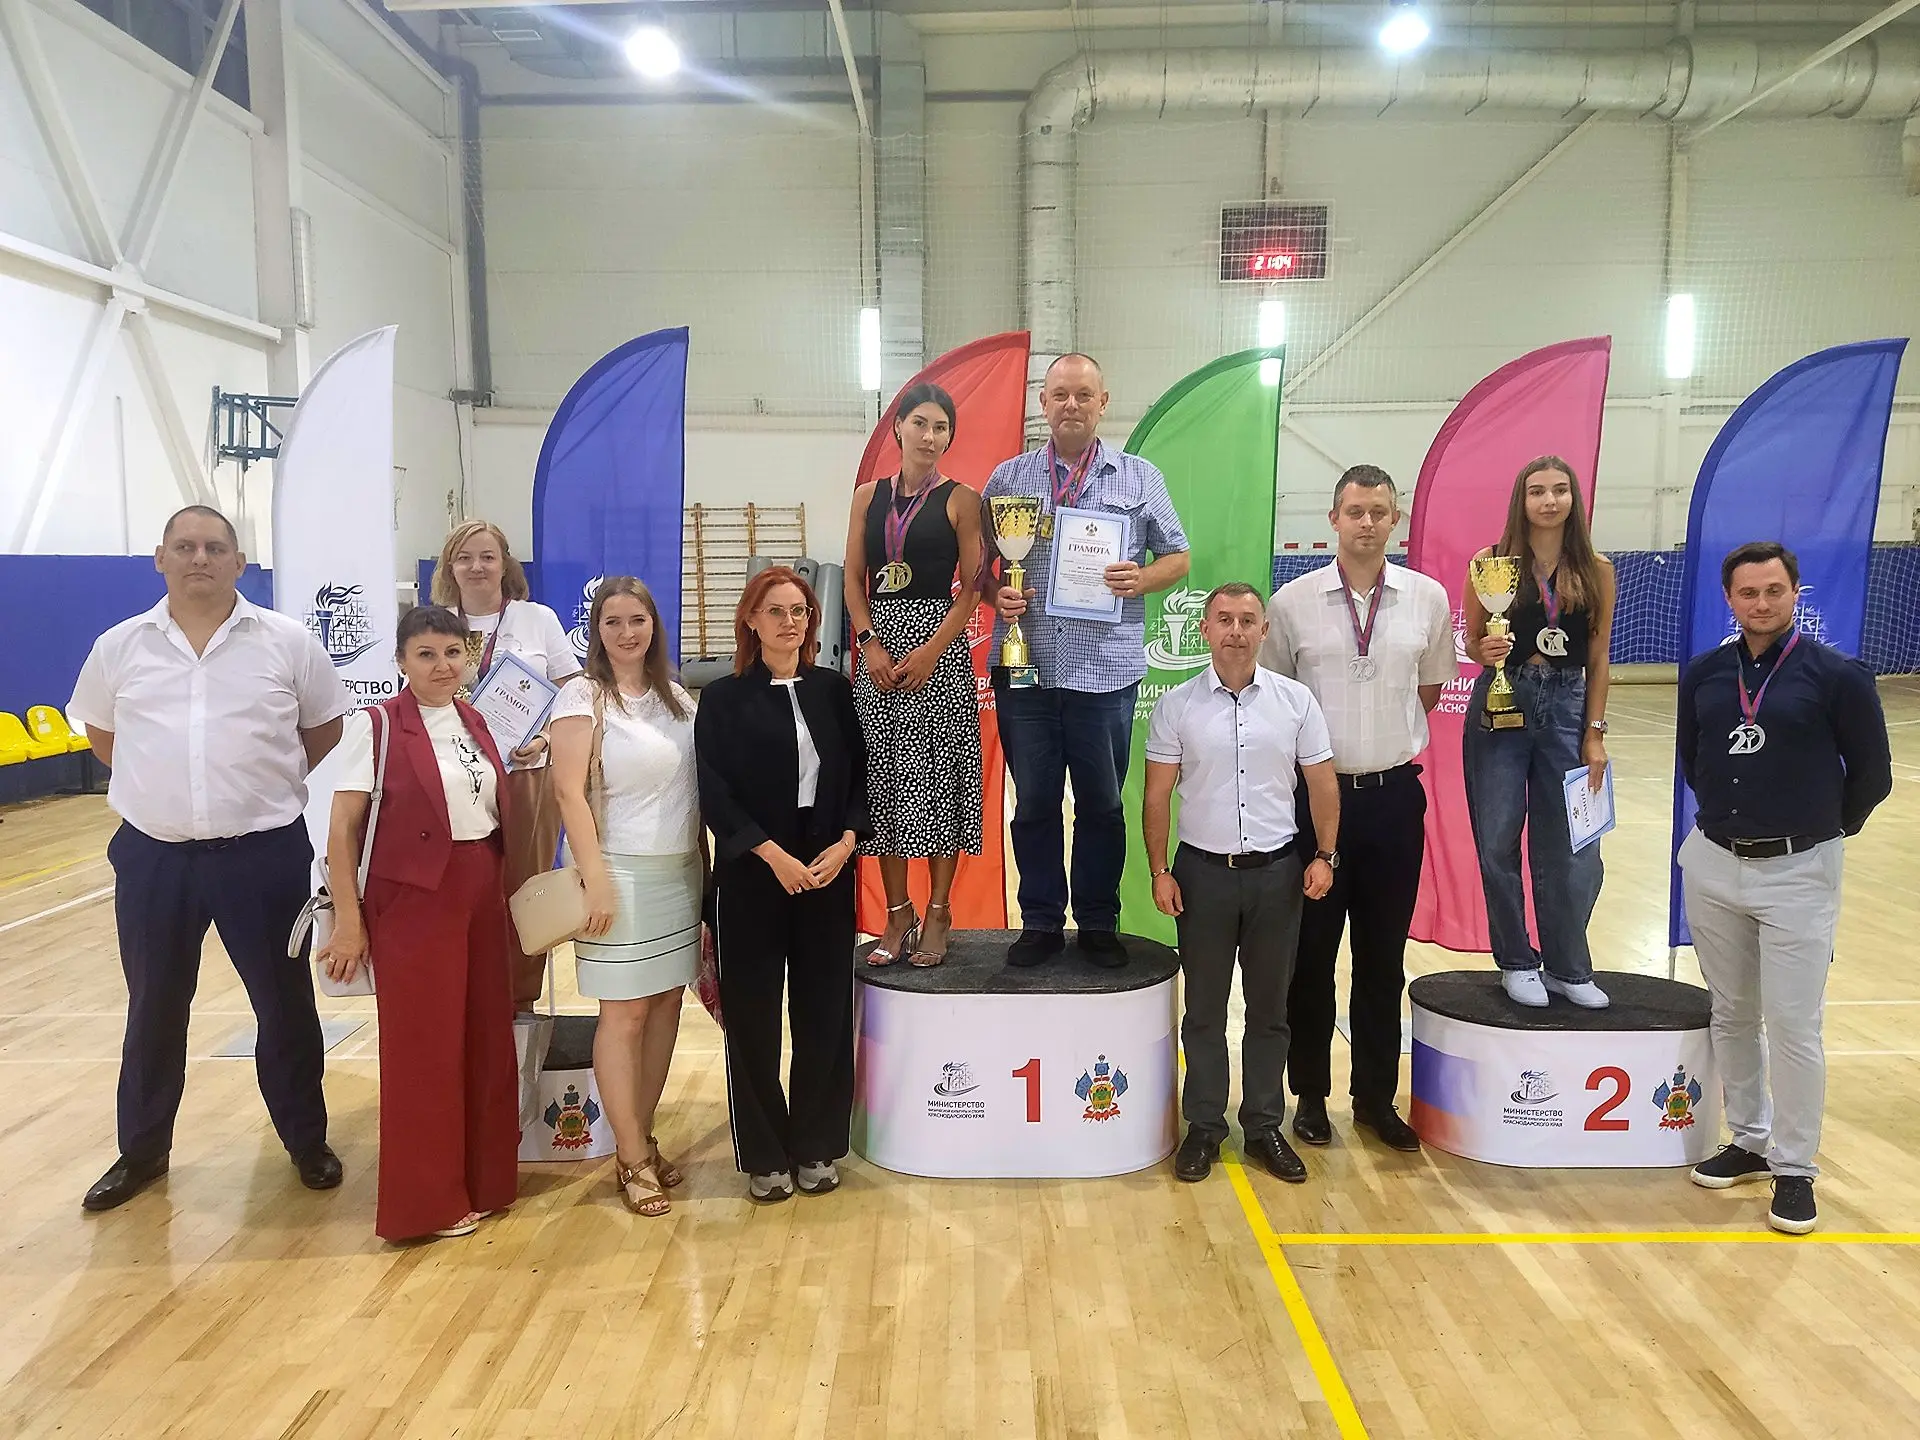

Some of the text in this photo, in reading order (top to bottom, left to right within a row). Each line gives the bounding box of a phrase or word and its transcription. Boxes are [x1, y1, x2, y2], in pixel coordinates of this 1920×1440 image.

[1255, 256, 1292, 270] 21:04
[1068, 543, 1111, 555] ГРАМОТА
[494, 686, 531, 716] ГРАМОТА
[1434, 703, 1467, 714] АСНО
[1012, 1058, 1041, 1122] 1
[927, 1100, 985, 1109] МИНИСТЕРСТВО
[1584, 1066, 1631, 1131] 2
[1503, 1107, 1563, 1117] МИНИСТЕРСТВО
